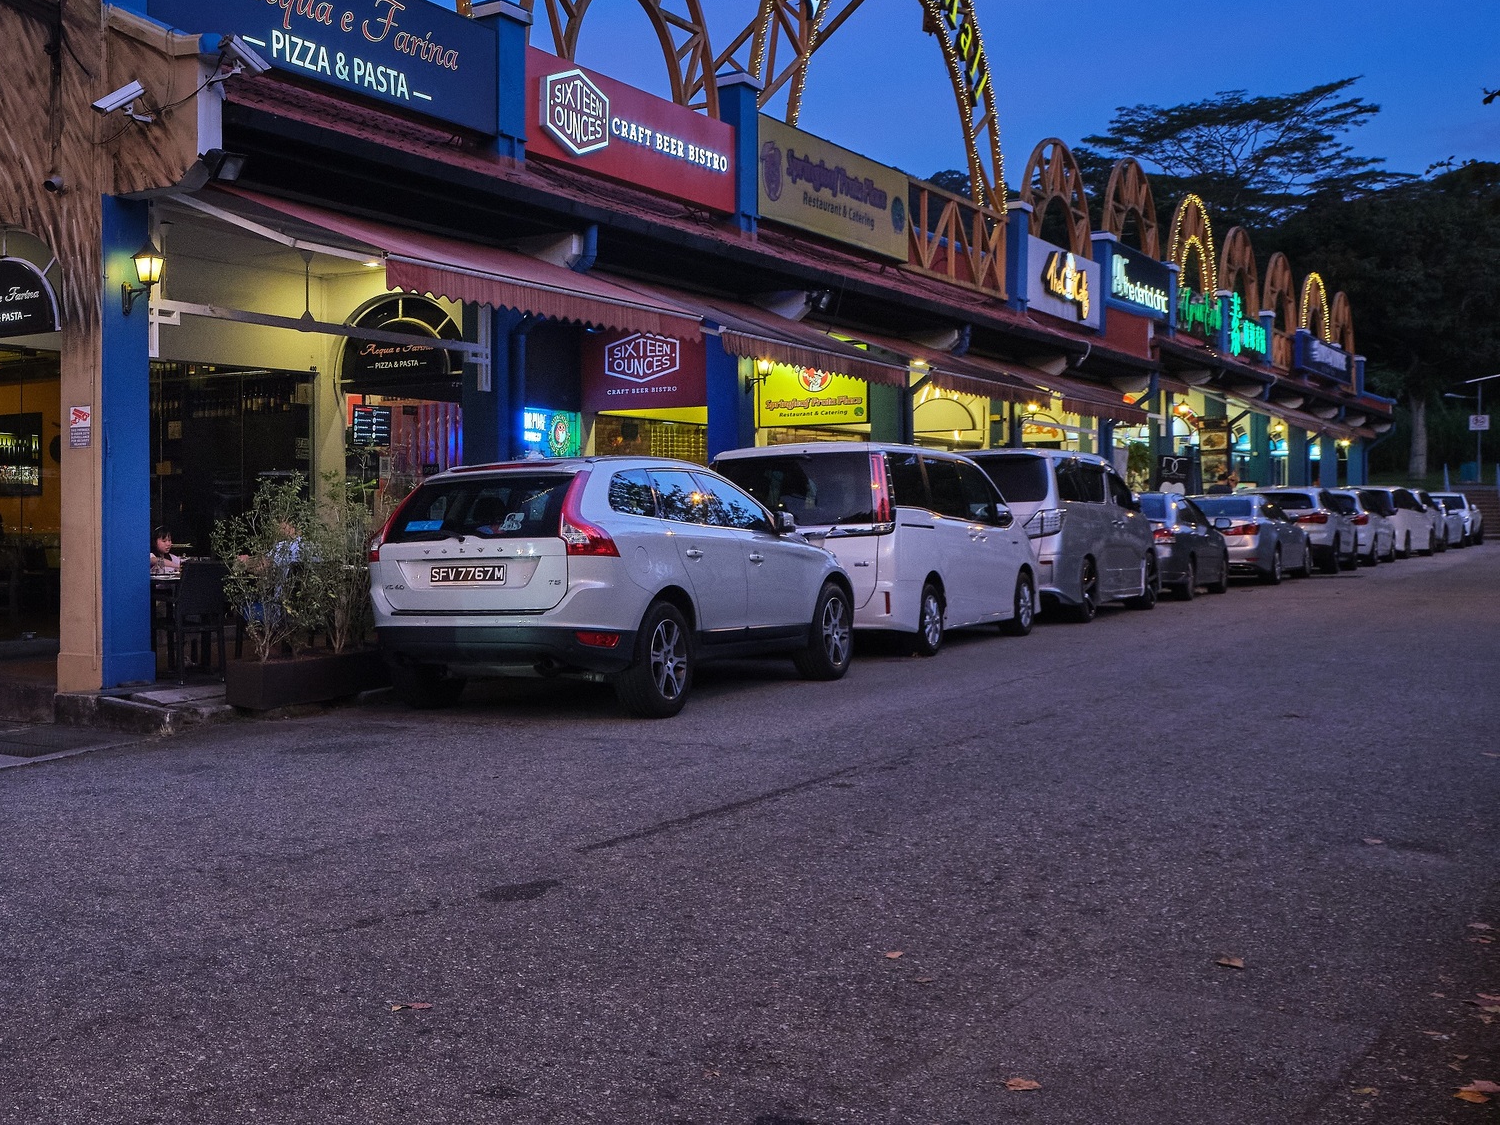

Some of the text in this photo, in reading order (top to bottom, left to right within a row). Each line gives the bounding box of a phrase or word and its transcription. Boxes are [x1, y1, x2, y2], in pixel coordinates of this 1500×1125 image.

[340, 10, 354, 32] e
[271, 30, 410, 100] PIZZA & PASTA
[554, 79, 603, 118] SIXTEEN
[554, 106, 602, 144] OUNCES
[611, 117, 728, 173] CRAFT BEER BISTRO
[803, 191, 842, 216] Restaurant
[848, 208, 875, 231] Catering
[5, 286, 40, 302] Farina
[2, 312, 23, 322] PASTA
[360, 343, 394, 357] Acqua
[614, 338, 670, 359] SIXTEEN
[399, 360, 418, 368] PASTA
[614, 356, 670, 377] OUNCES
[431, 566, 504, 582] SFV7767M
